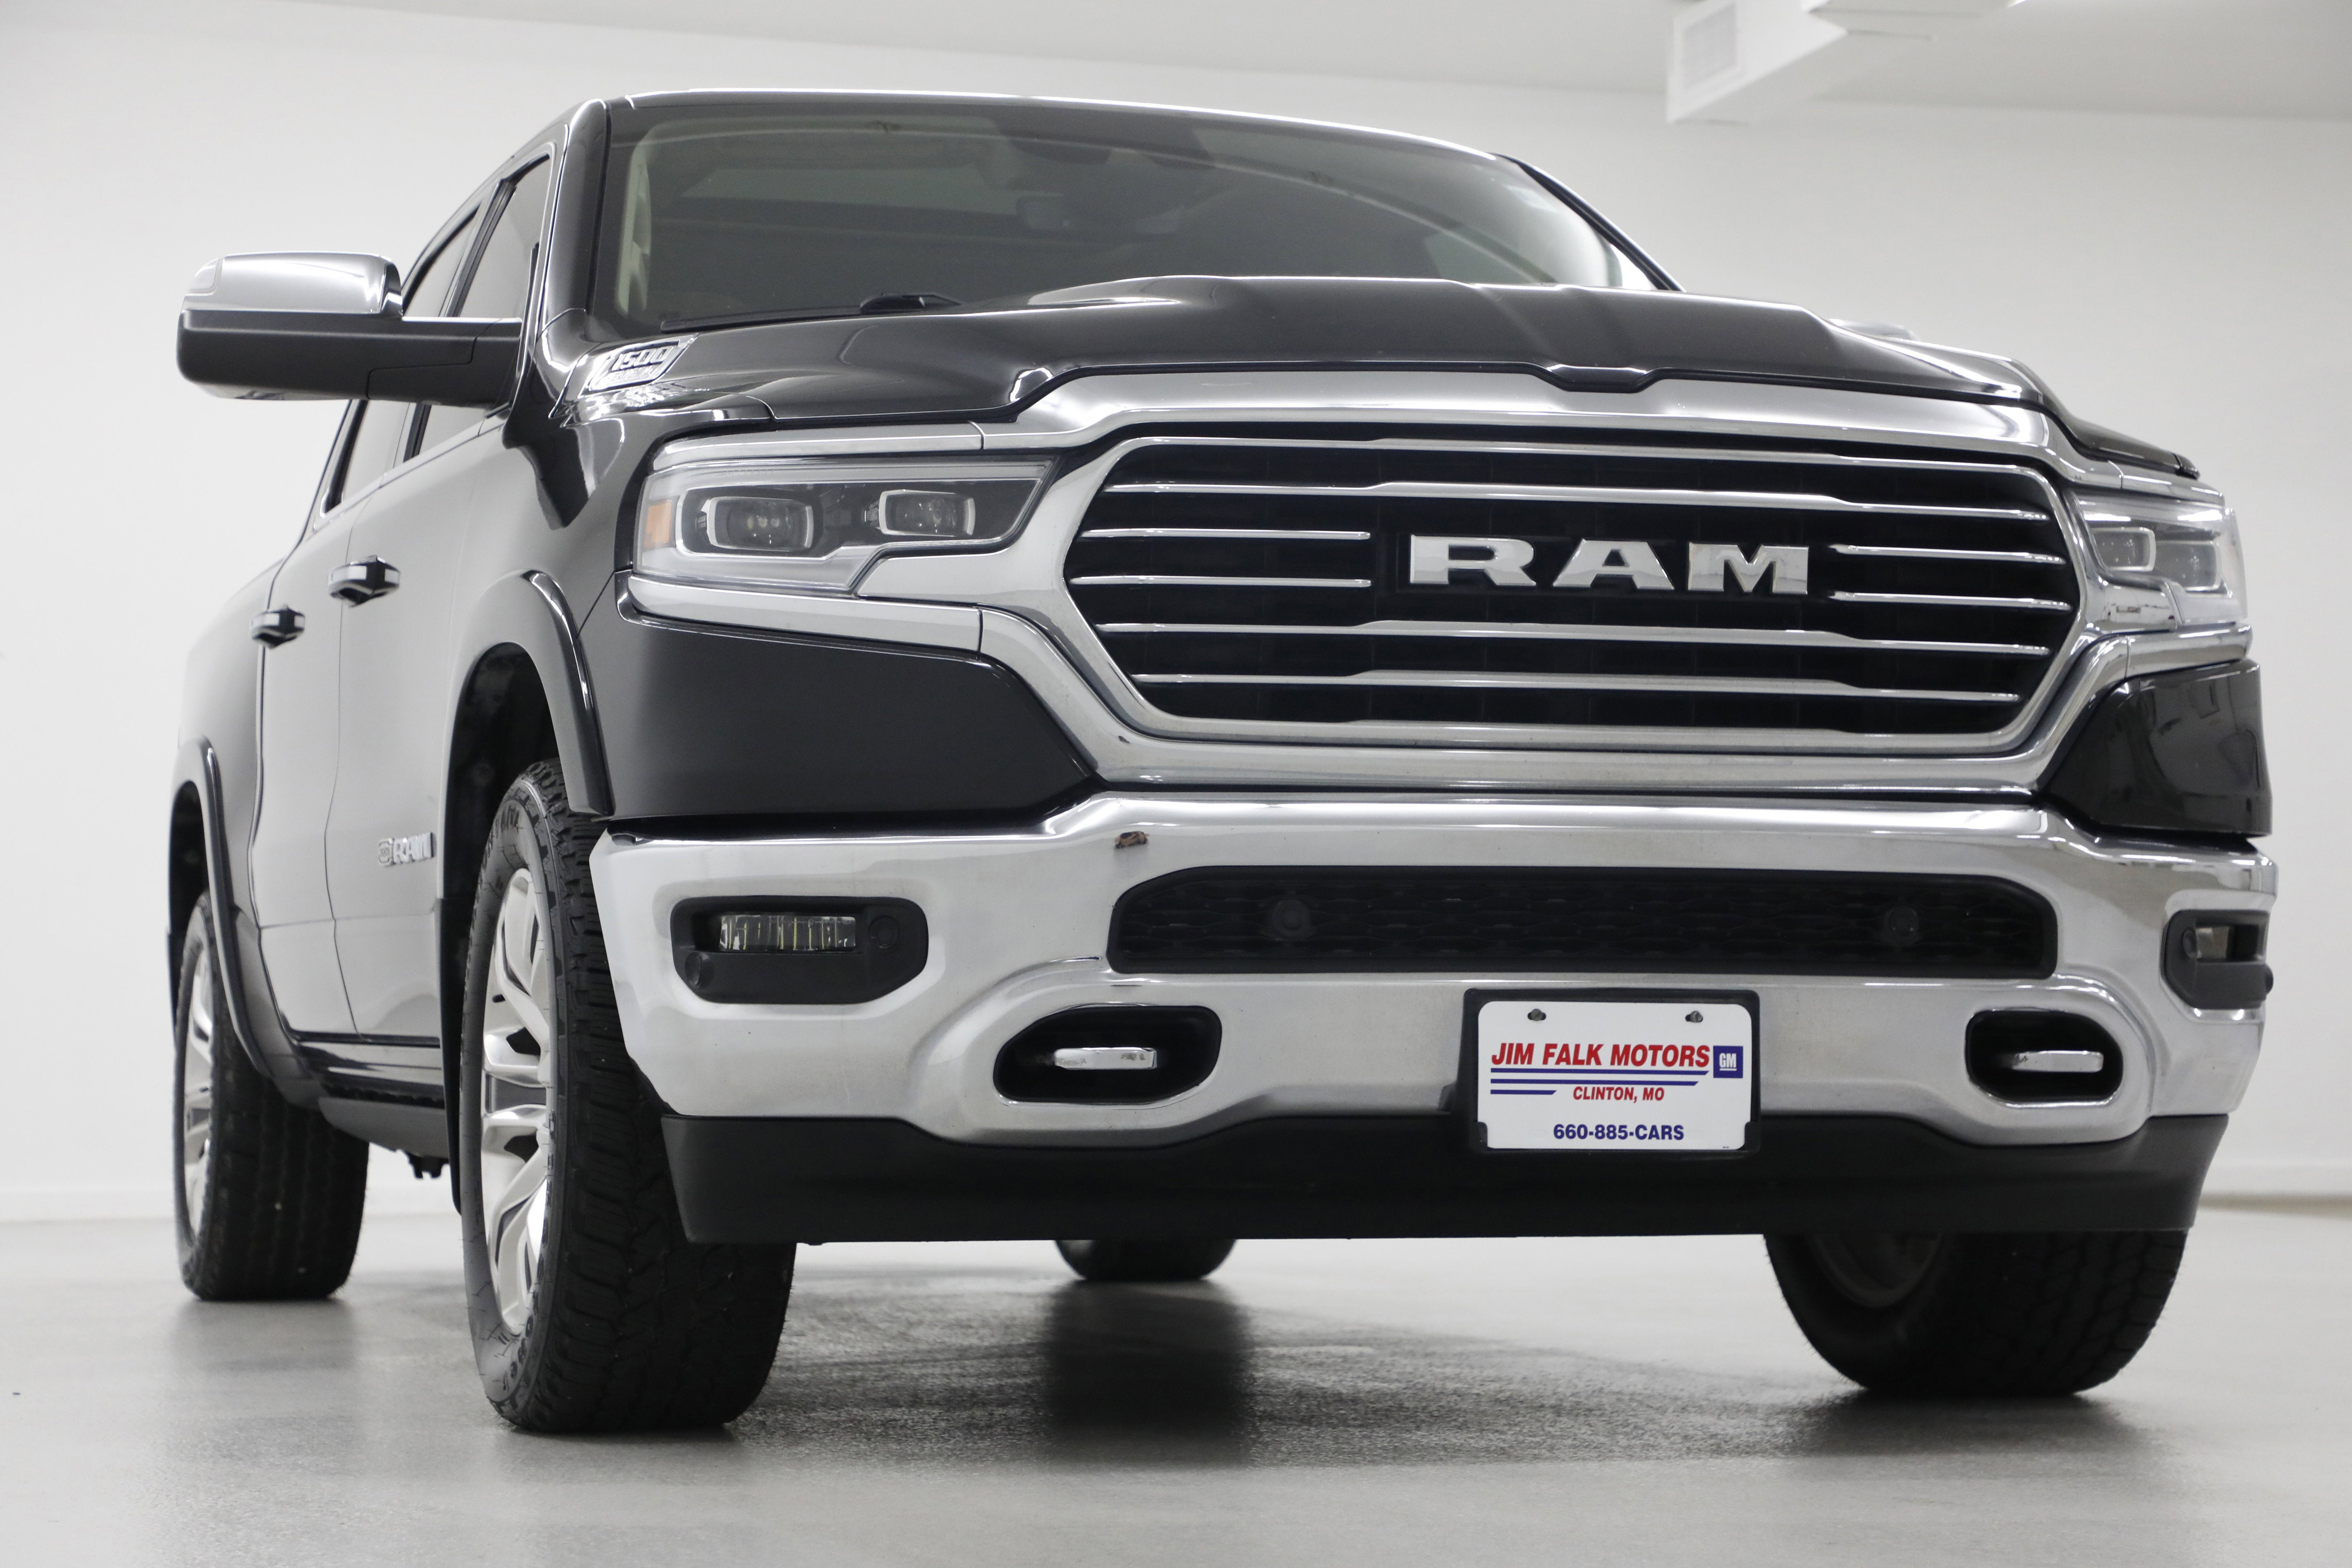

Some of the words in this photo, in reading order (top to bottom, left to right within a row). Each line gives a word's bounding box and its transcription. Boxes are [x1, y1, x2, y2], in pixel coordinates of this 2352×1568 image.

[611, 347, 674, 371] 1500
[1409, 534, 1809, 595] RAM
[1491, 1042, 1535, 1065] JIM
[1542, 1043, 1603, 1066] FALK
[1610, 1044, 1710, 1067] MOTORS
[1719, 1053, 1737, 1067] GM
[1573, 1086, 1637, 1102] CLINTON,
[1643, 1087, 1664, 1101] MO
[1553, 1124, 1684, 1140] 660-885-CARS
